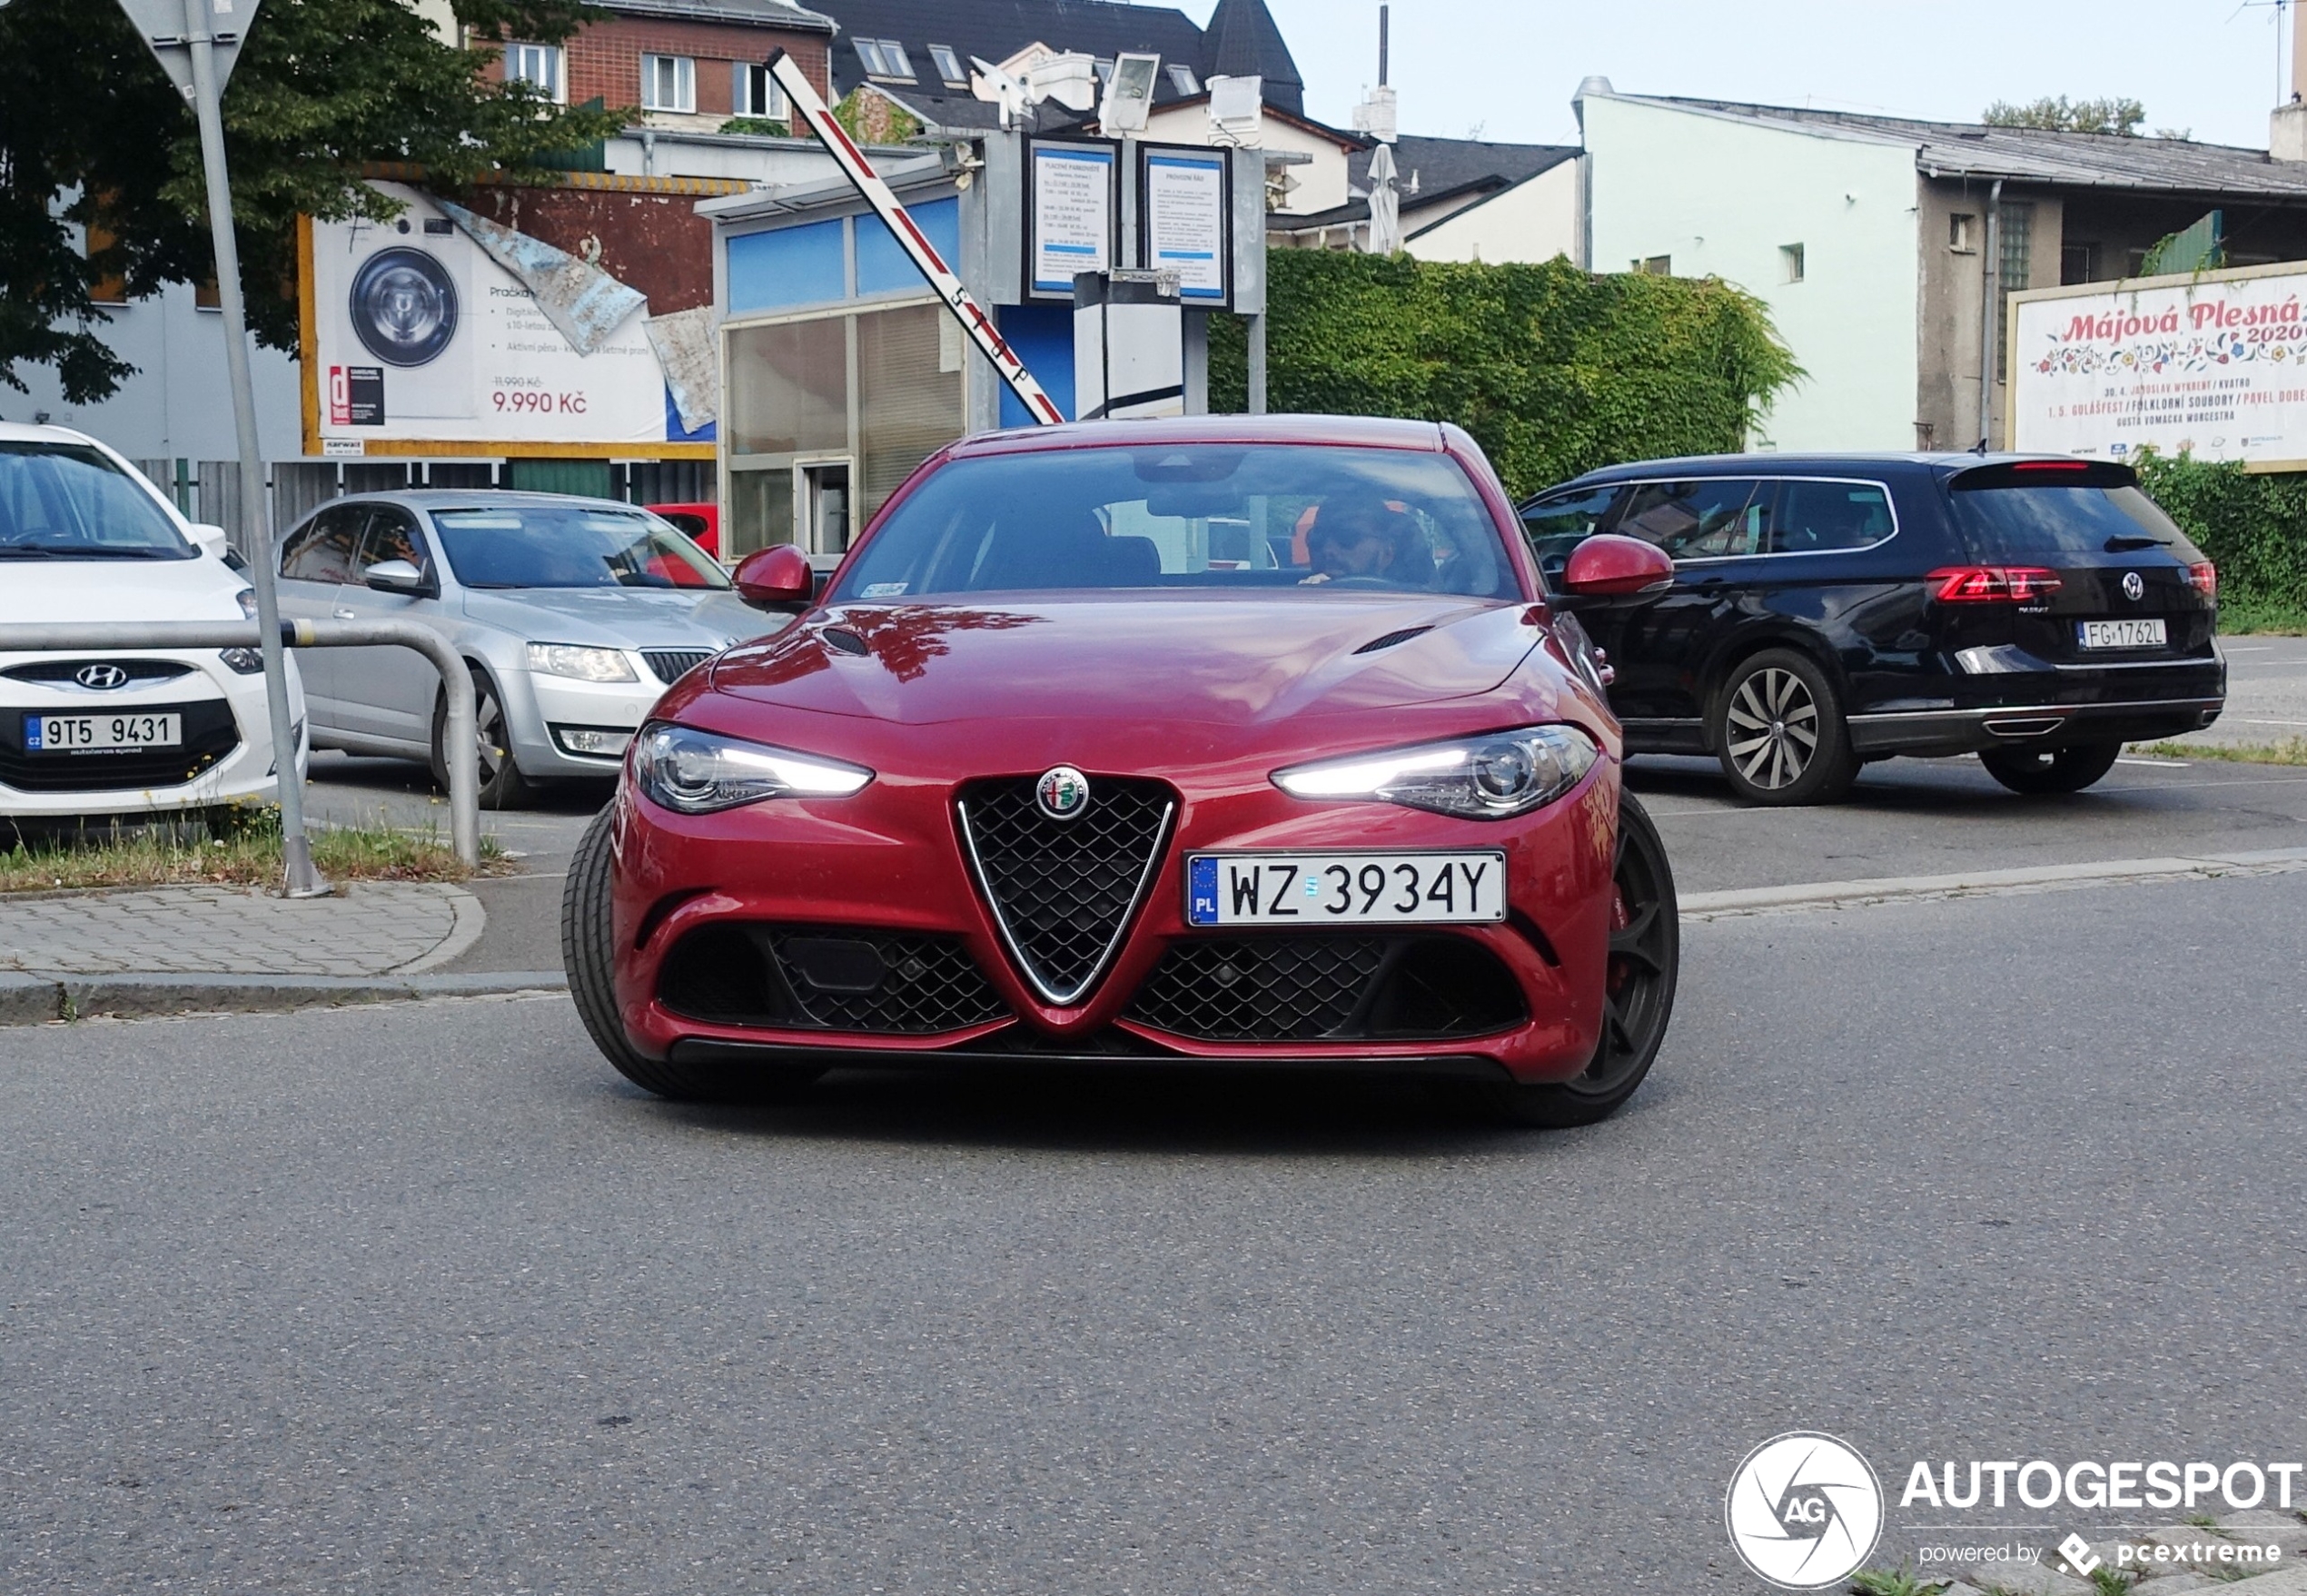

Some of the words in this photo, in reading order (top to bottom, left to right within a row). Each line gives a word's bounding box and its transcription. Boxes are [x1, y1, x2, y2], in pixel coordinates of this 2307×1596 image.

[490, 286, 530, 298] Pračka
[2061, 303, 2179, 346] Májová
[2186, 293, 2300, 330] Plesná
[950, 286, 1029, 382] STOP
[2247, 324, 2303, 343] 2020
[506, 342, 536, 352] Aktivní
[527, 377, 542, 388] Kč
[2131, 383, 2171, 395] JAROSLAV
[2219, 377, 2251, 389] KVATRO
[492, 392, 552, 412] 9.990
[559, 391, 588, 413] Kč
[2072, 400, 2123, 416] GULÁŠFEST
[2132, 394, 2184, 412] FOLKLORNÍ
[2188, 393, 2233, 408] SOUBORY
[2243, 391, 2273, 405] PAVEL
[2279, 389, 2307, 402] DOBE
[2089, 622, 2111, 645] FG
[2117, 621, 2163, 645] 1762L
[48, 719, 93, 745] 9T5
[112, 717, 168, 743] 9431
[28, 737, 41, 747] CZ
[1231, 864, 1299, 916] WZ
[1323, 862, 1488, 915] 3934Y
[1195, 897, 1215, 913] PL
